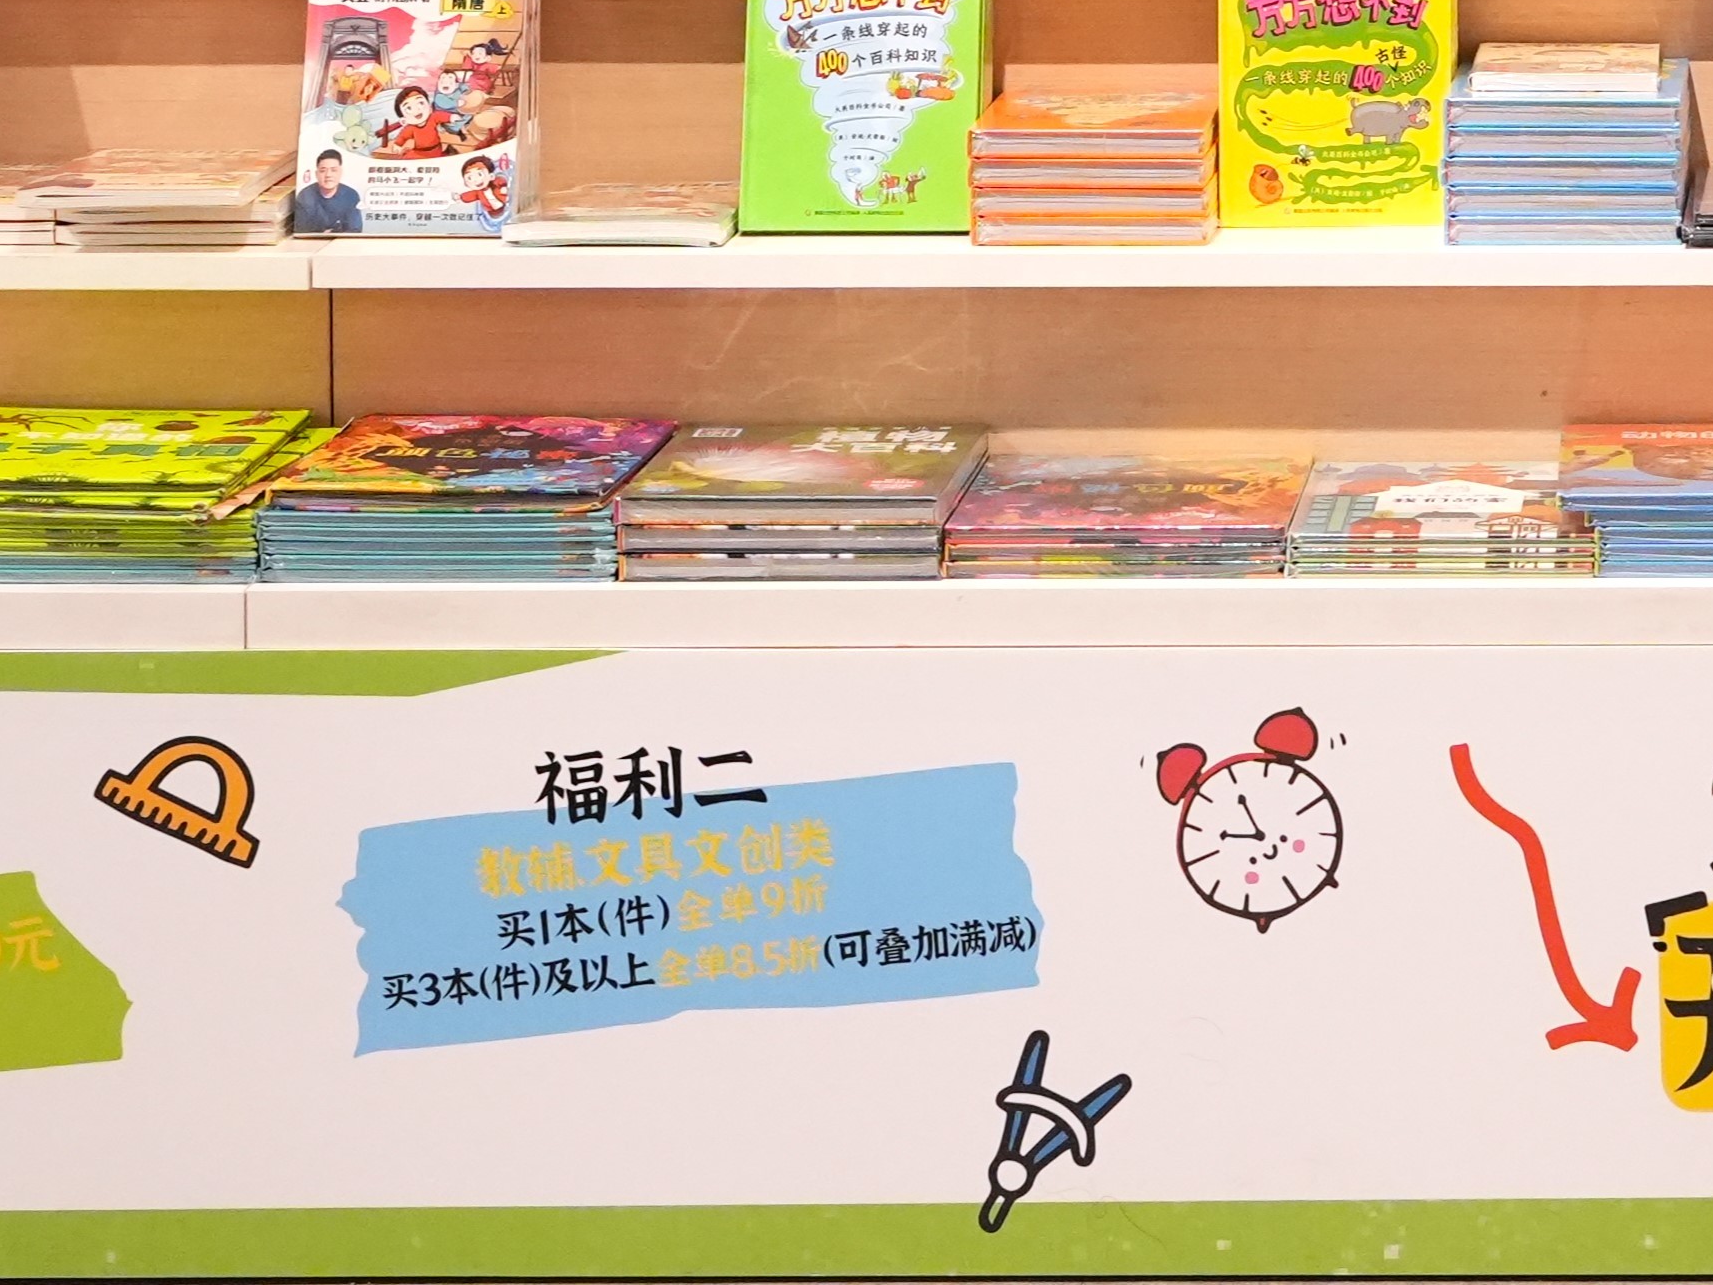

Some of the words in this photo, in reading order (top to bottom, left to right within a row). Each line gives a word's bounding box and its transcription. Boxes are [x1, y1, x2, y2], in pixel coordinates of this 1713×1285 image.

[822, 22, 928, 42] 一条线穿起的
[534, 746, 768, 824] 福利二
